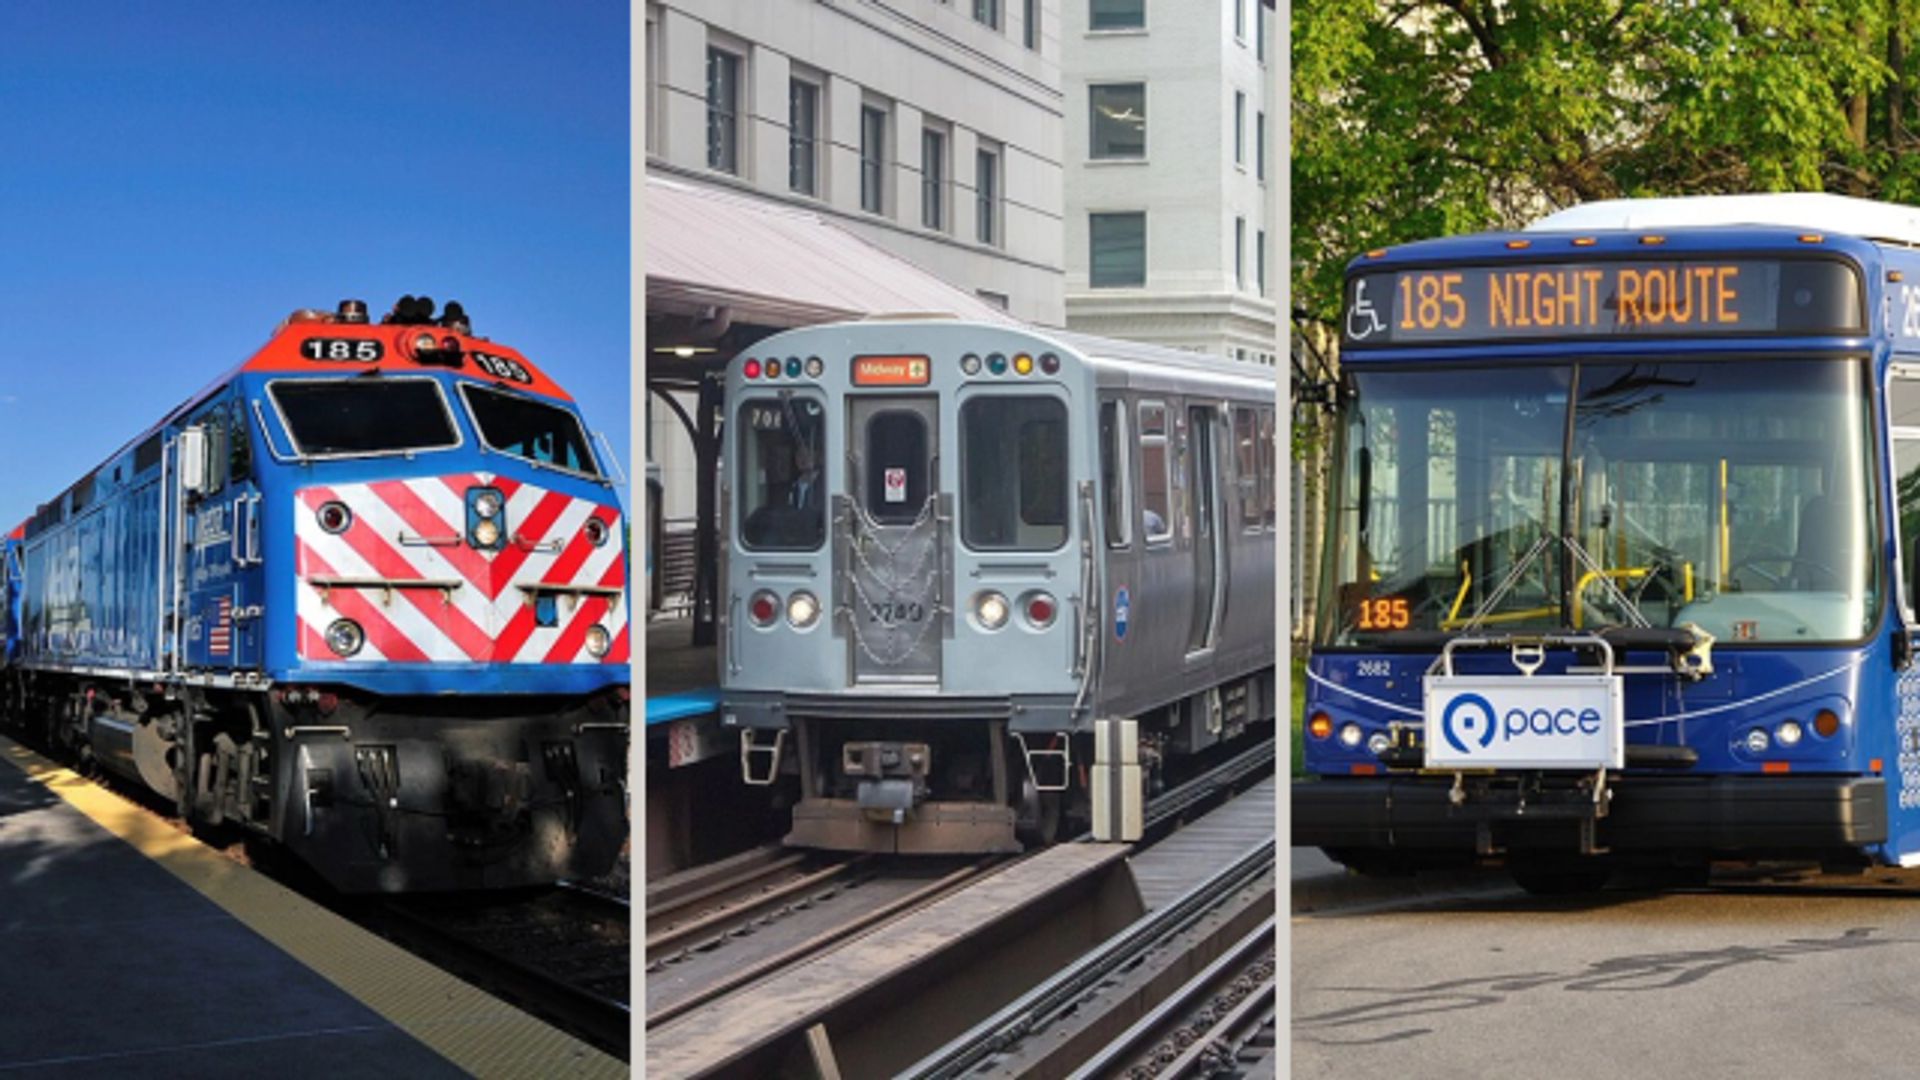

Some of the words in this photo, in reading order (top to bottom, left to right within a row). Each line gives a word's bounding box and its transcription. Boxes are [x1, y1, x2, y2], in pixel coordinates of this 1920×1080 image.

[1400, 274, 1466, 328] 185
[1488, 270, 1603, 327] NIGHT
[1618, 267, 1739, 324] ROUTE
[308, 341, 377, 360] 185
[476, 354, 530, 383] 185
[860, 361, 907, 377] Midway
[1359, 599, 1409, 628] 185
[1357, 660, 1390, 676] 2682
[1504, 708, 1601, 741] pace
